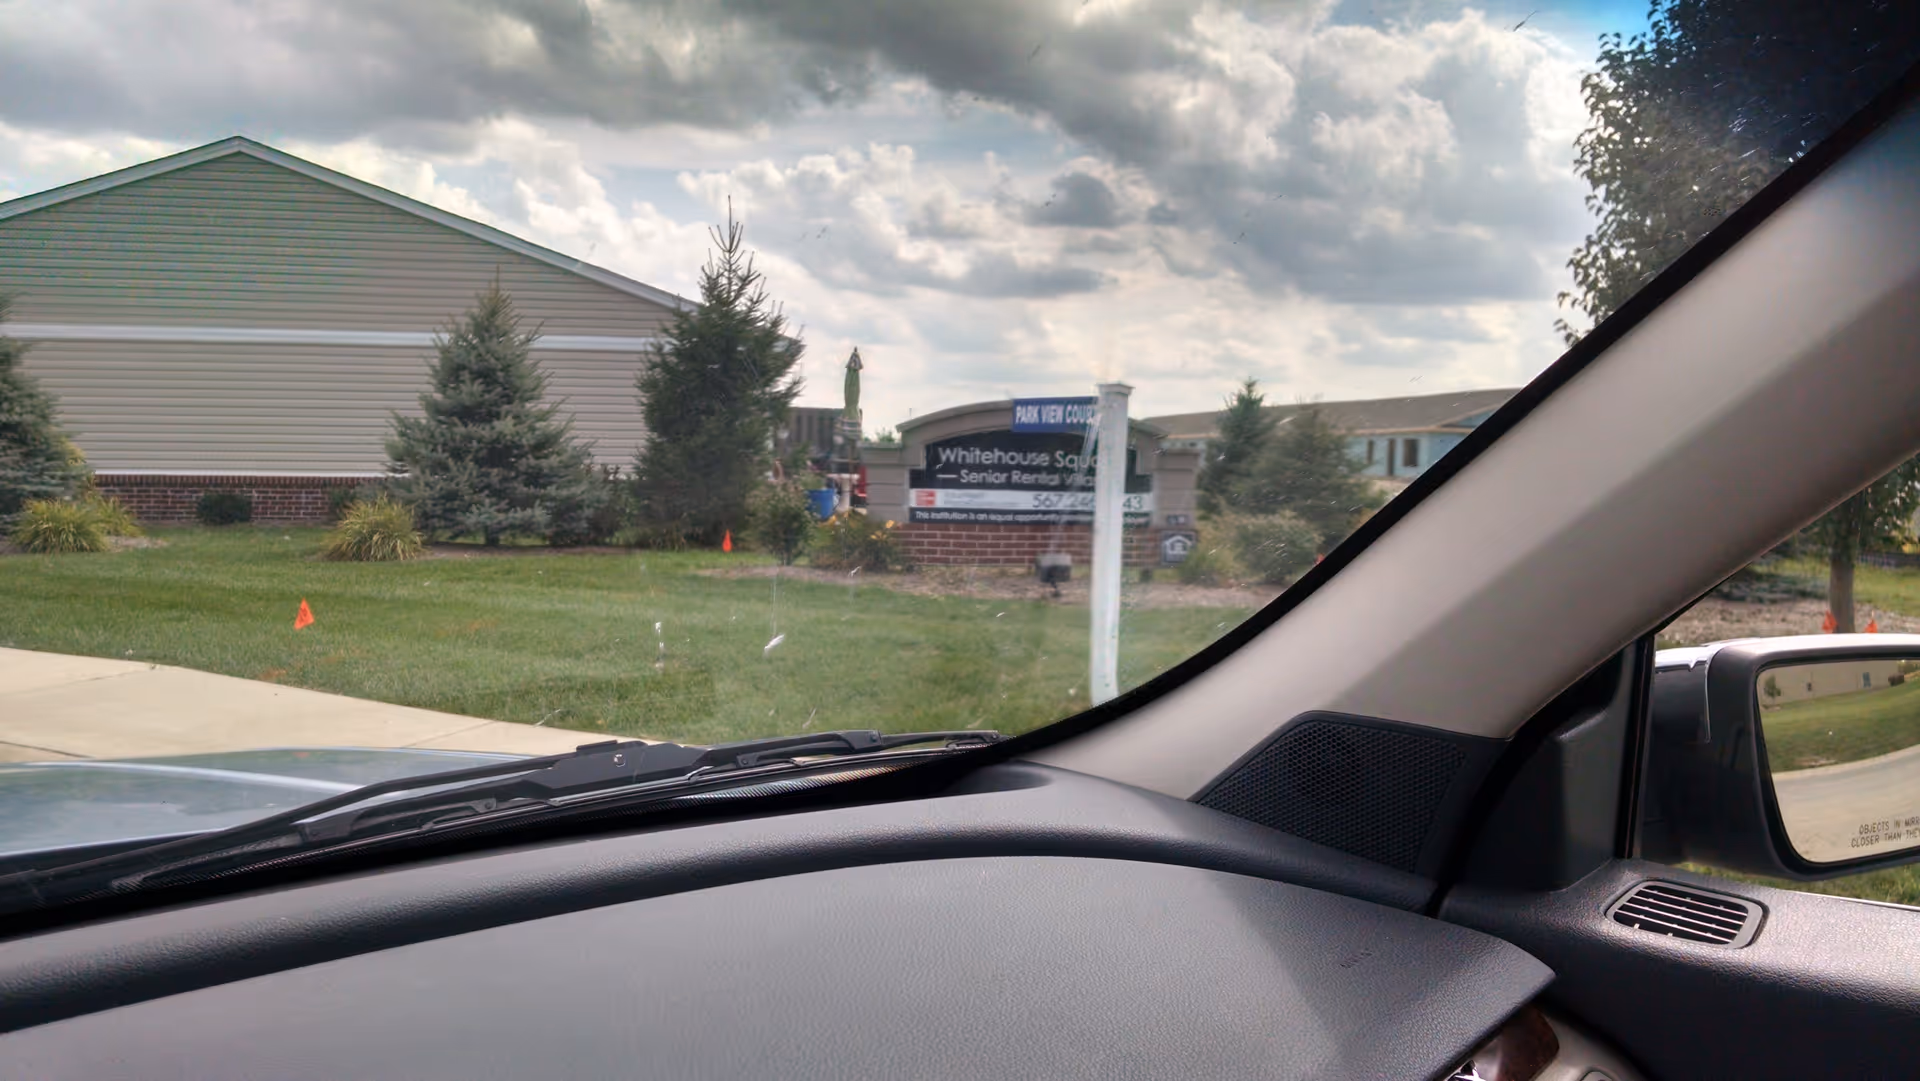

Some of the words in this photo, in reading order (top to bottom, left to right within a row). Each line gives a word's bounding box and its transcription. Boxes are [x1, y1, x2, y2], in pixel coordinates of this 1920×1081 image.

[1015, 405, 1040, 424] PARK
[1041, 405, 1064, 424] VIEW
[1065, 404, 1100, 425] COUR
[938, 447, 1050, 466] Whitehouse
[1054, 450, 1100, 471] Squa
[960, 469, 1008, 483] Senior
[1011, 470, 1060, 486] Rental
[915, 511, 930, 520] This
[931, 511, 967, 521] institution
[977, 512, 988, 521] an
[1859, 820, 1890, 835] OBJECTS
[1893, 819, 1901, 829] IN
[1851, 834, 1880, 848] CLOSER
[1884, 832, 1902, 841] THAN
